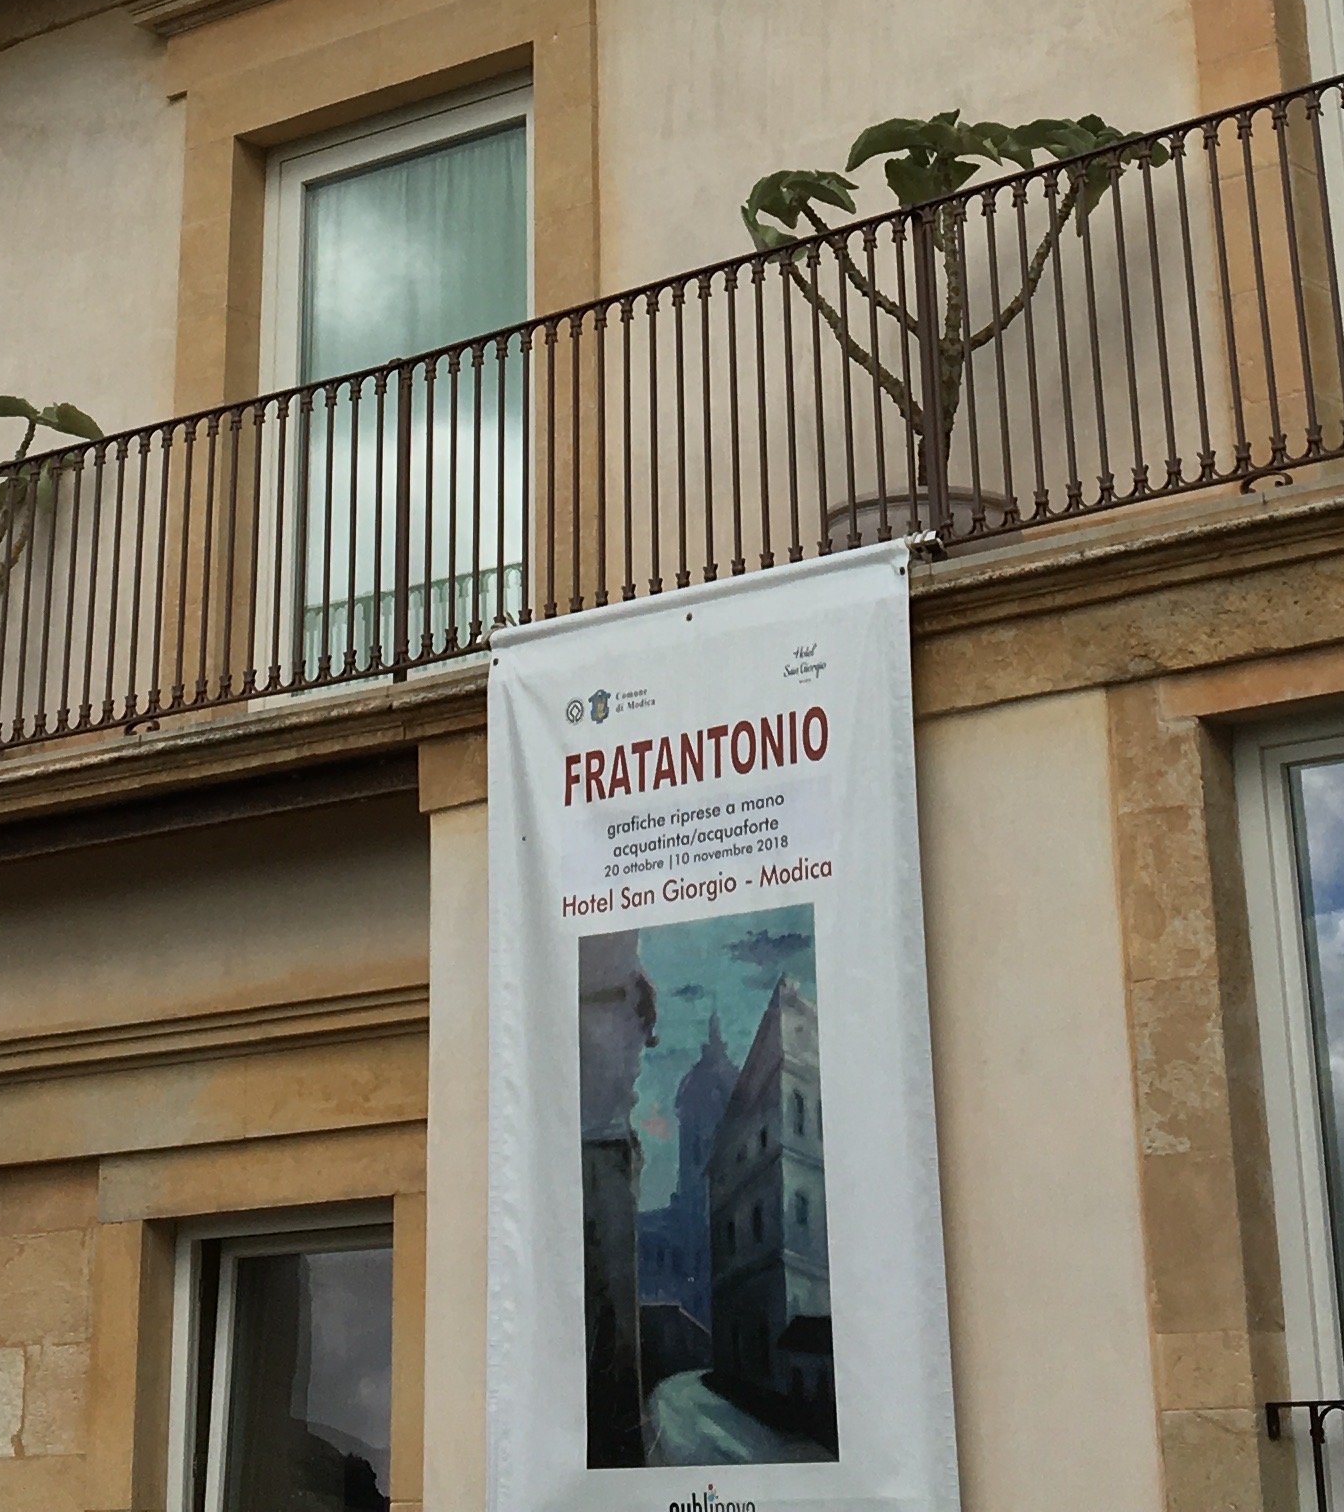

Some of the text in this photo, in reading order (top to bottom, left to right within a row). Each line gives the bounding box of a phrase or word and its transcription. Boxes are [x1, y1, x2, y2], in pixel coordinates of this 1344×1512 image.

[563, 706, 829, 807] FRATANTONIO
[607, 793, 785, 839] grafiche riprese a mano
[613, 816, 779, 858] acquatinta/acquaforte
[604, 864, 620, 878] 20
[623, 858, 664, 875] ottobre
[693, 845, 753, 863] novembre
[757, 835, 789, 853] 2018
[562, 889, 613, 917] Hotel
[620, 886, 655, 910] San
[662, 871, 737, 901] Giorgio
[759, 857, 833, 888] Modica
